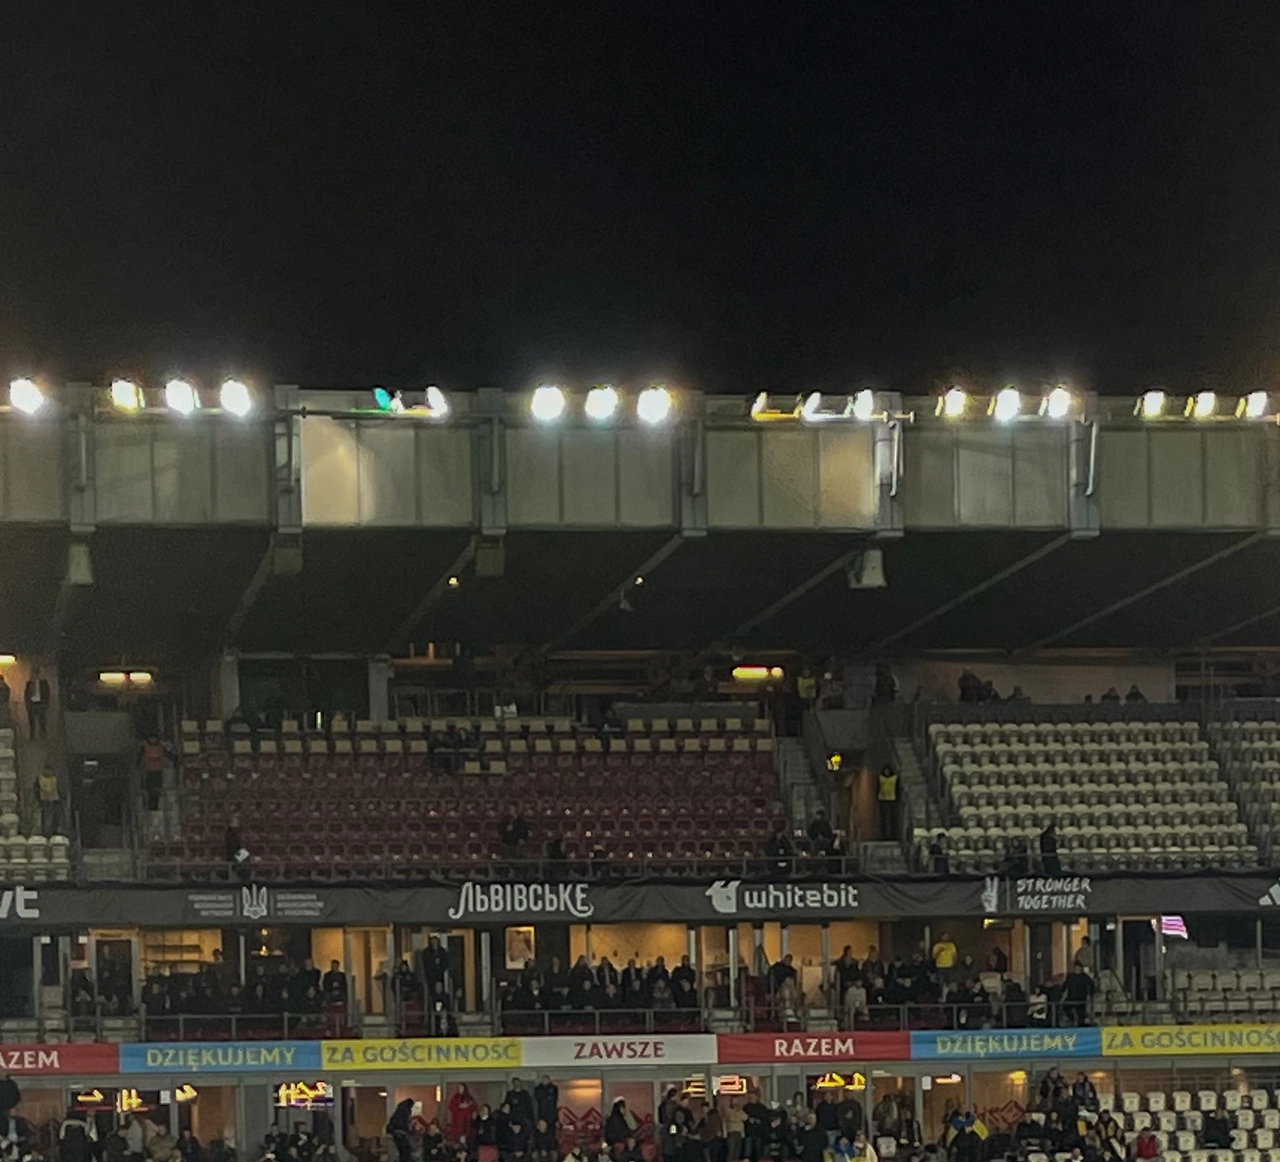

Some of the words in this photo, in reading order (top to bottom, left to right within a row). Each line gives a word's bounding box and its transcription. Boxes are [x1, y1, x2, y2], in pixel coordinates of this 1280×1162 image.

[744, 883, 859, 909] whitebit
[1017, 877, 1092, 893] STRONGER
[448, 882, 594, 919] ЛЬВІВСЬКЕ
[1017, 893, 1087, 910] TOGETHER
[573, 1041, 666, 1060] ZAWSZE
[773, 1037, 856, 1058] RAZEM
[936, 1033, 1079, 1058] DZIĘKUJEMY
[1106, 1028, 1135, 1050] ZA
[146, 1046, 297, 1071] DZIĘKUJEMY
[326, 1045, 356, 1065] ZA
[362, 1040, 518, 1063] GOŚCINNOŚĆ
